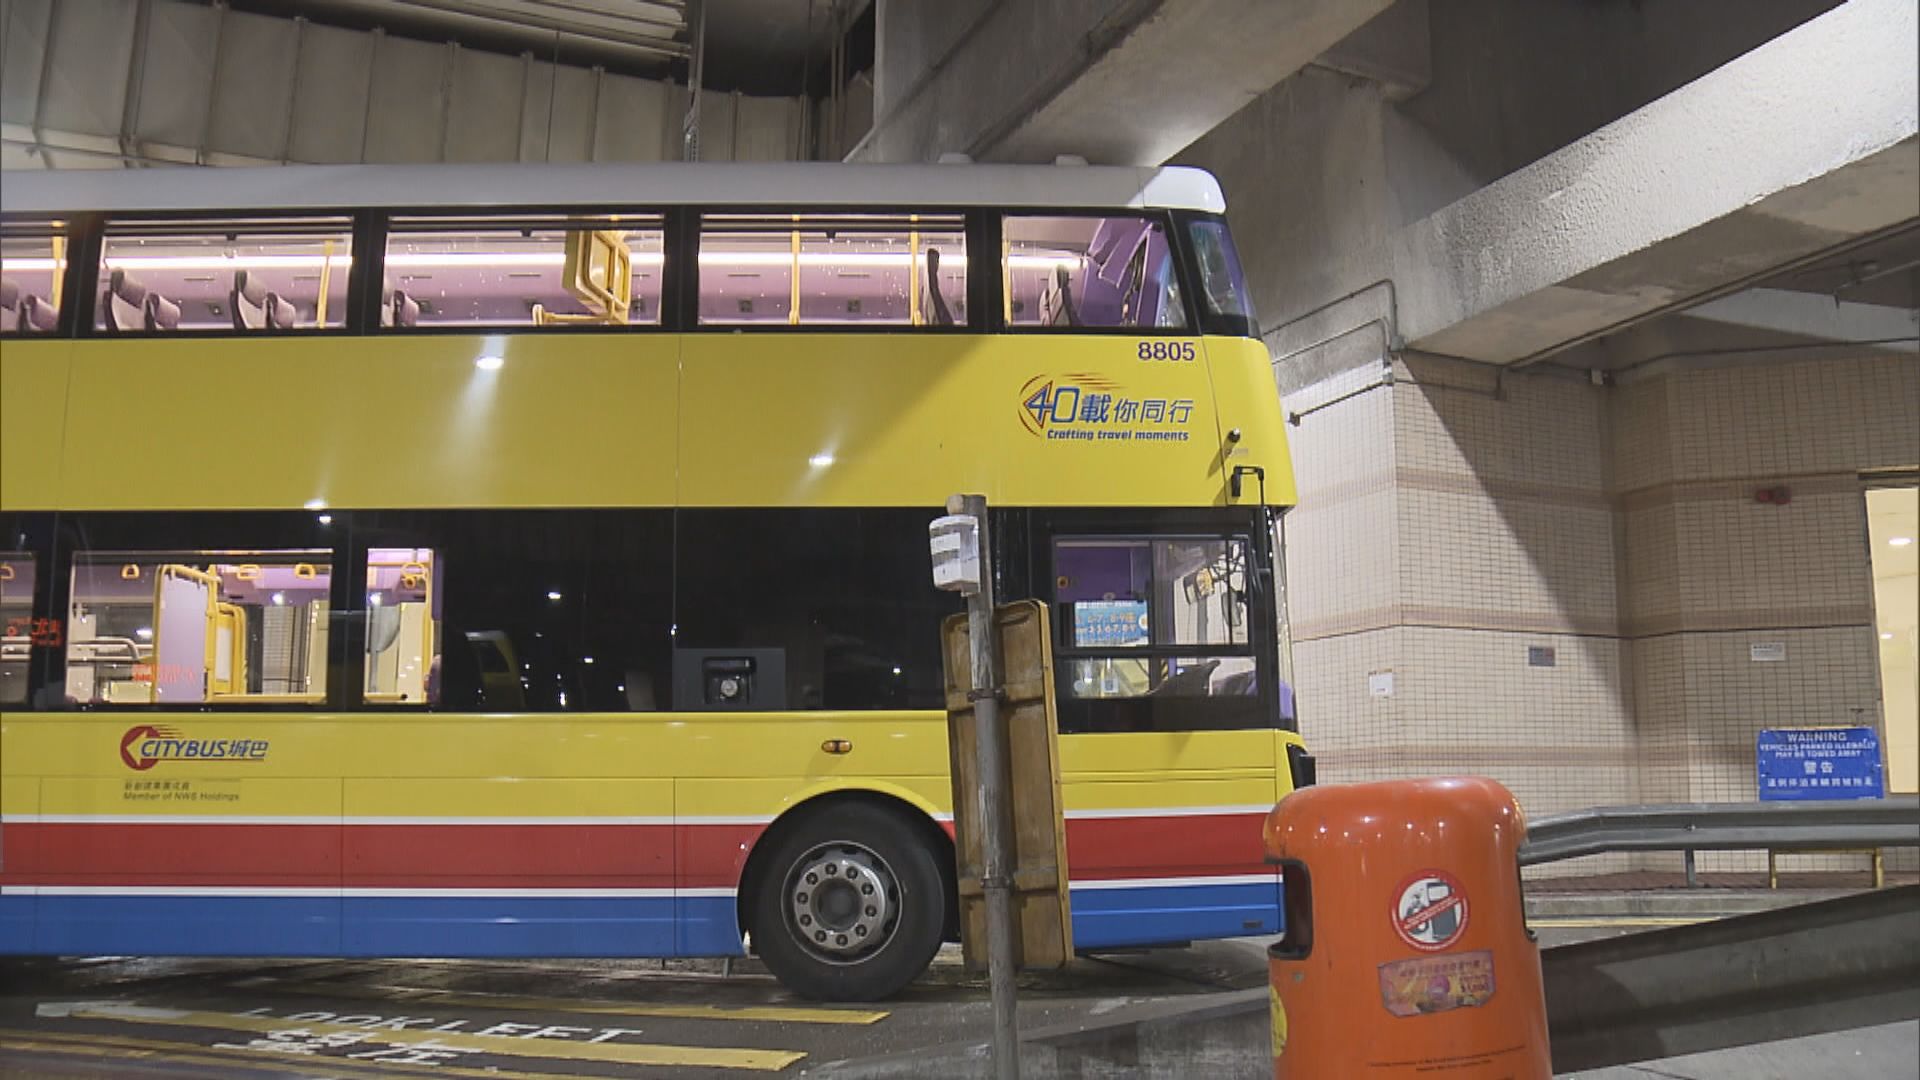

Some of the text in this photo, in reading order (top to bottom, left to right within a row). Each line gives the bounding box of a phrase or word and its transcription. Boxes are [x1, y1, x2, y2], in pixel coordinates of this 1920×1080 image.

[1138, 341, 1196, 361] 8805
[1047, 429, 1189, 441] Crafting travel moments
[1787, 732, 1847, 742] WARNING
[140, 739, 268, 758] CITYBUS 城巴
[123, 792, 161, 801] Member
[163, 792, 172, 801] of
[199, 792, 240, 803] Holdings
[237, 1008, 644, 1043] LOOK LEFT
